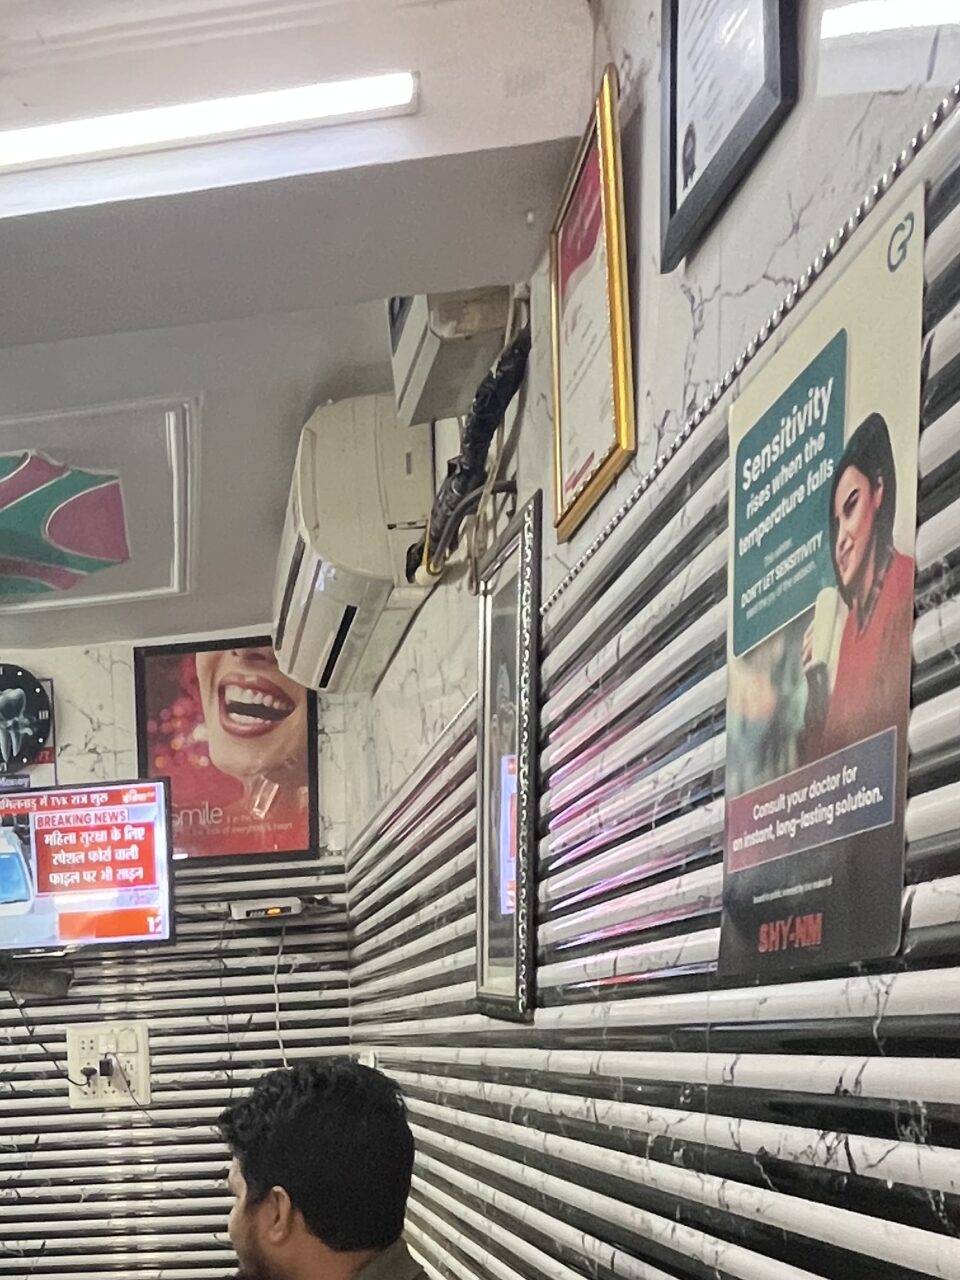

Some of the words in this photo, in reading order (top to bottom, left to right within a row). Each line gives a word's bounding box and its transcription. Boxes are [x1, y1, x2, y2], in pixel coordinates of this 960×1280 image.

[742, 377, 834, 491] Sensitivity
[746, 484, 771, 520] rises
[772, 453, 802, 494] when
[804, 431, 825, 463] the
[739, 484, 806, 556] temperature
[807, 458, 834, 496] falls
[763, 568, 775, 592] LET
[775, 530, 823, 580] SENSITIVITY
[38, 710, 49, 719] III
[40, 794, 48, 806] में
[71, 794, 88, 805] राज
[753, 793, 786, 821] Consult
[786, 785, 809, 813] your
[809, 773, 841, 799] doctor
[842, 765, 858, 784] for
[36, 813, 92, 828] BREAKING
[94, 811, 127, 824] NEWS
[44, 829, 77, 846] महिला
[80, 829, 108, 847] सुरक्षा
[110, 826, 122, 841] के
[124, 824, 146, 841] लिए
[732, 838, 743, 852] an
[744, 823, 776, 846] instant,
[776, 800, 835, 838] long-lasting
[835, 786, 884, 817] solution.
[52, 849, 85, 865] स्पेशल
[88, 846, 112, 863] फोर्स
[114, 844, 139, 861] वाली
[49, 870, 80, 887] फाइल
[83, 869, 97, 883] पर
[101, 865, 113, 881] भी
[116, 867, 144, 883] साइन
